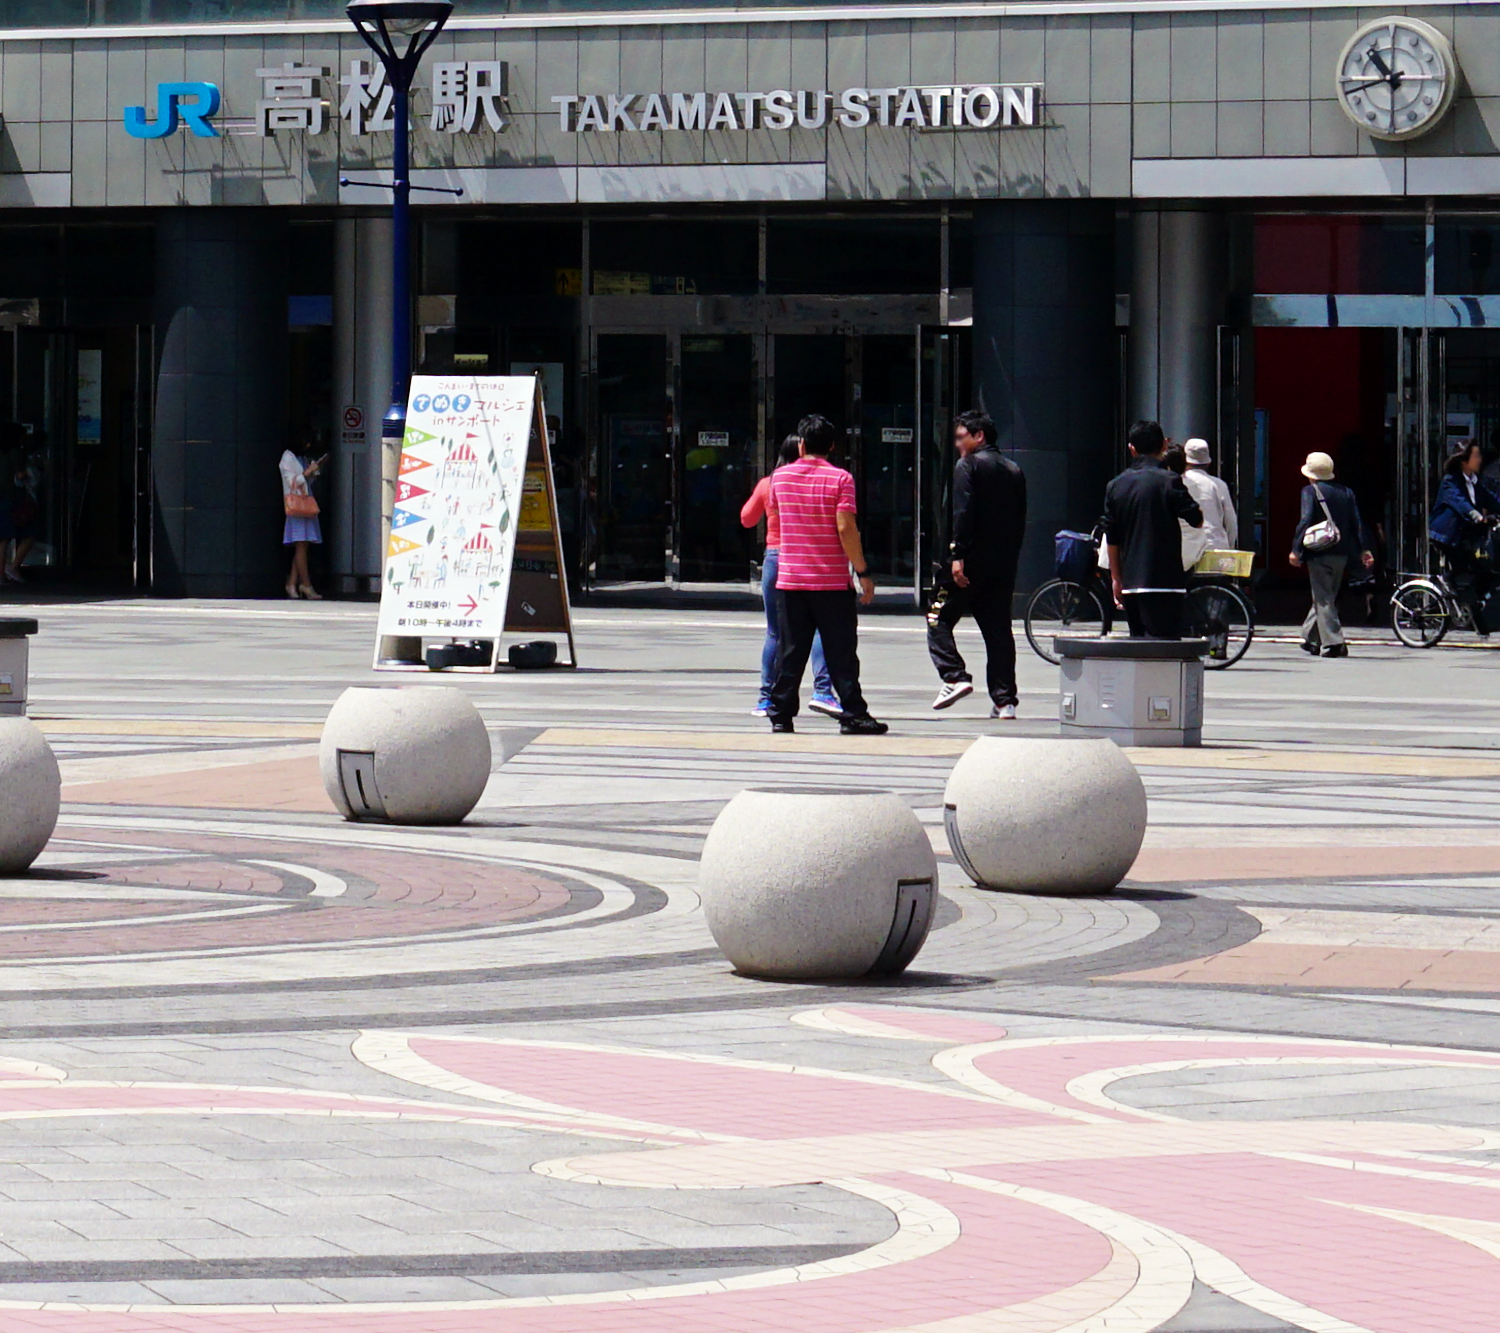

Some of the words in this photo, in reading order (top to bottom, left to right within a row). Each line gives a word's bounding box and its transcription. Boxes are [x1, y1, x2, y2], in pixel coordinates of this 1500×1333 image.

[124, 80, 221, 140] JR
[254, 60, 509, 138] 高松駅
[550, 88, 832, 133] TAKAMATSU
[839, 82, 1045, 131] STATION
